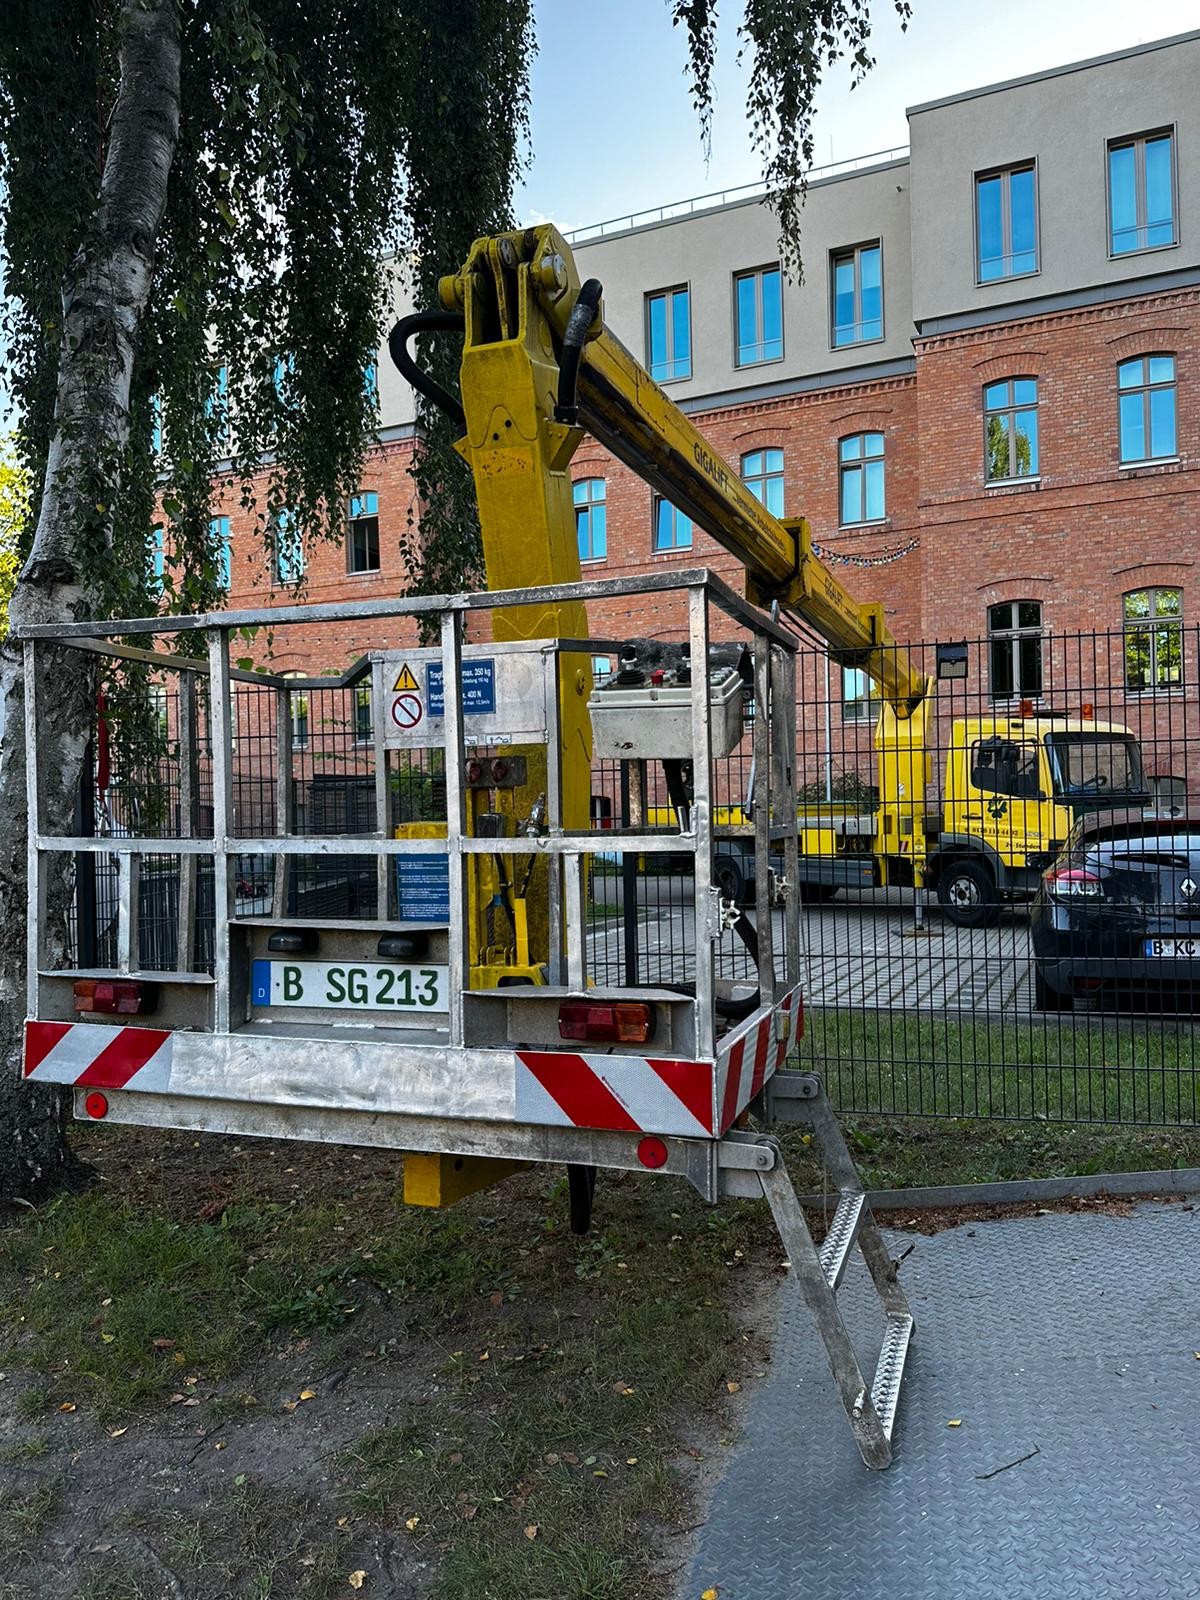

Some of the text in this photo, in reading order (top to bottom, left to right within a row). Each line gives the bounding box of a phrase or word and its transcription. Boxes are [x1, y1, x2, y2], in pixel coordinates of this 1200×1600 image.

[693, 442, 729, 493] GIGALIFT
[474, 667, 484, 676] 350
[484, 668, 491, 678] kg
[477, 690, 482, 698] N
[1153, 940, 1164, 955] B
[258, 988, 266, 998] D
[283, 966, 304, 1002] B
